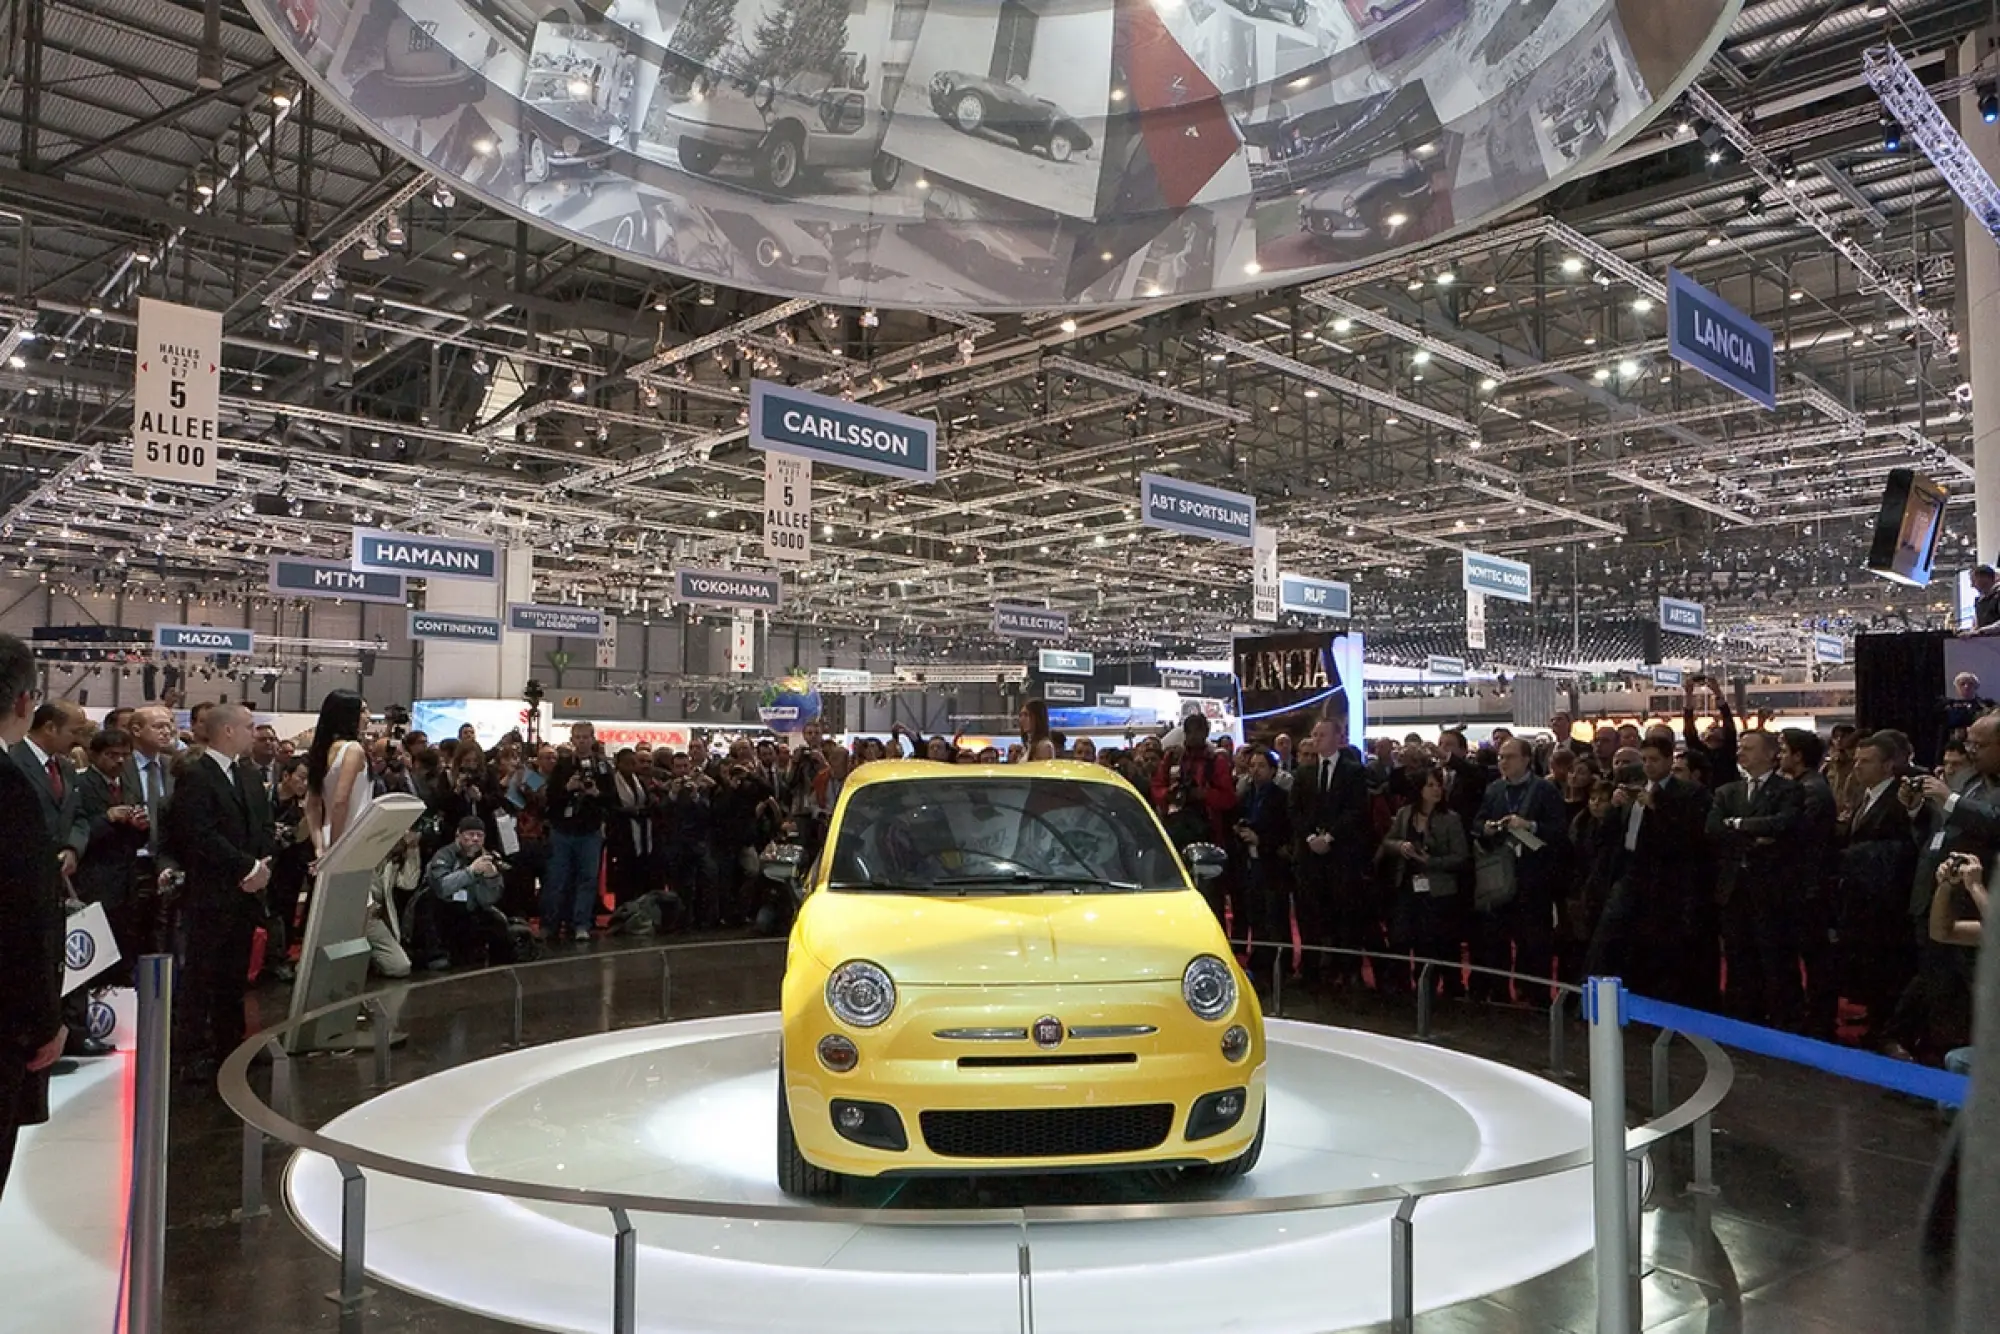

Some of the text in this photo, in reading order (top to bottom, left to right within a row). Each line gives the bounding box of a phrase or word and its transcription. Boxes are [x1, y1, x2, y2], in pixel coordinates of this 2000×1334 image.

[159, 343, 199, 360] HALLES
[1694, 309, 1756, 374] LANCIA
[170, 380, 186, 409] 5
[140, 411, 213, 441] ALLEE
[783, 411, 909, 456] CARLSSON
[147, 441, 204, 468] 5100
[783, 486, 793, 507] 5
[767, 509, 808, 529] ALLEE
[1150, 493, 1250, 528] ABT SPORTSLINE
[771, 531, 804, 550] 5000
[376, 543, 480, 569] HAMANN
[314, 569, 365, 589] MTM
[690, 579, 770, 598] YOKOHAMA
[1303, 586, 1327, 604] RUF
[415, 620, 496, 636] CONTINENTAL
[1020, 616, 1065, 631] ELECTRIC
[178, 633, 233, 646] MAZDA
[1239, 648, 1331, 691] LANCIA
